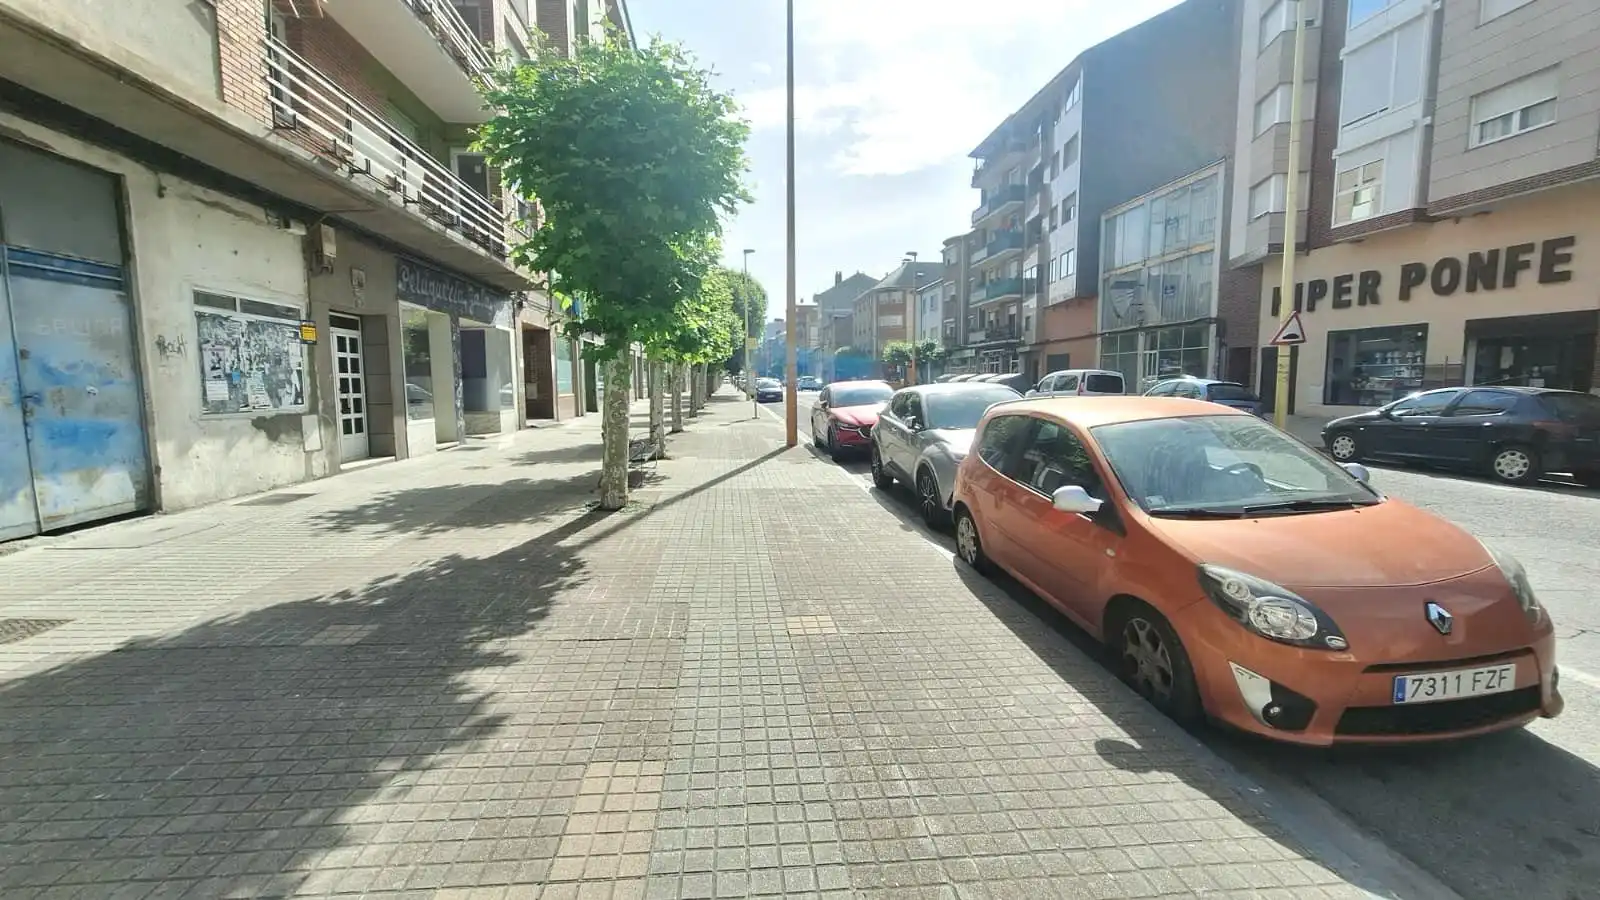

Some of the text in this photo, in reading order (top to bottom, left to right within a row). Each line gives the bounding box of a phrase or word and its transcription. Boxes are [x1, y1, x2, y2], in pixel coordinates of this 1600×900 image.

[1398, 235, 1576, 301] PONFE
[1411, 668, 1511, 698] 7311 FZF
